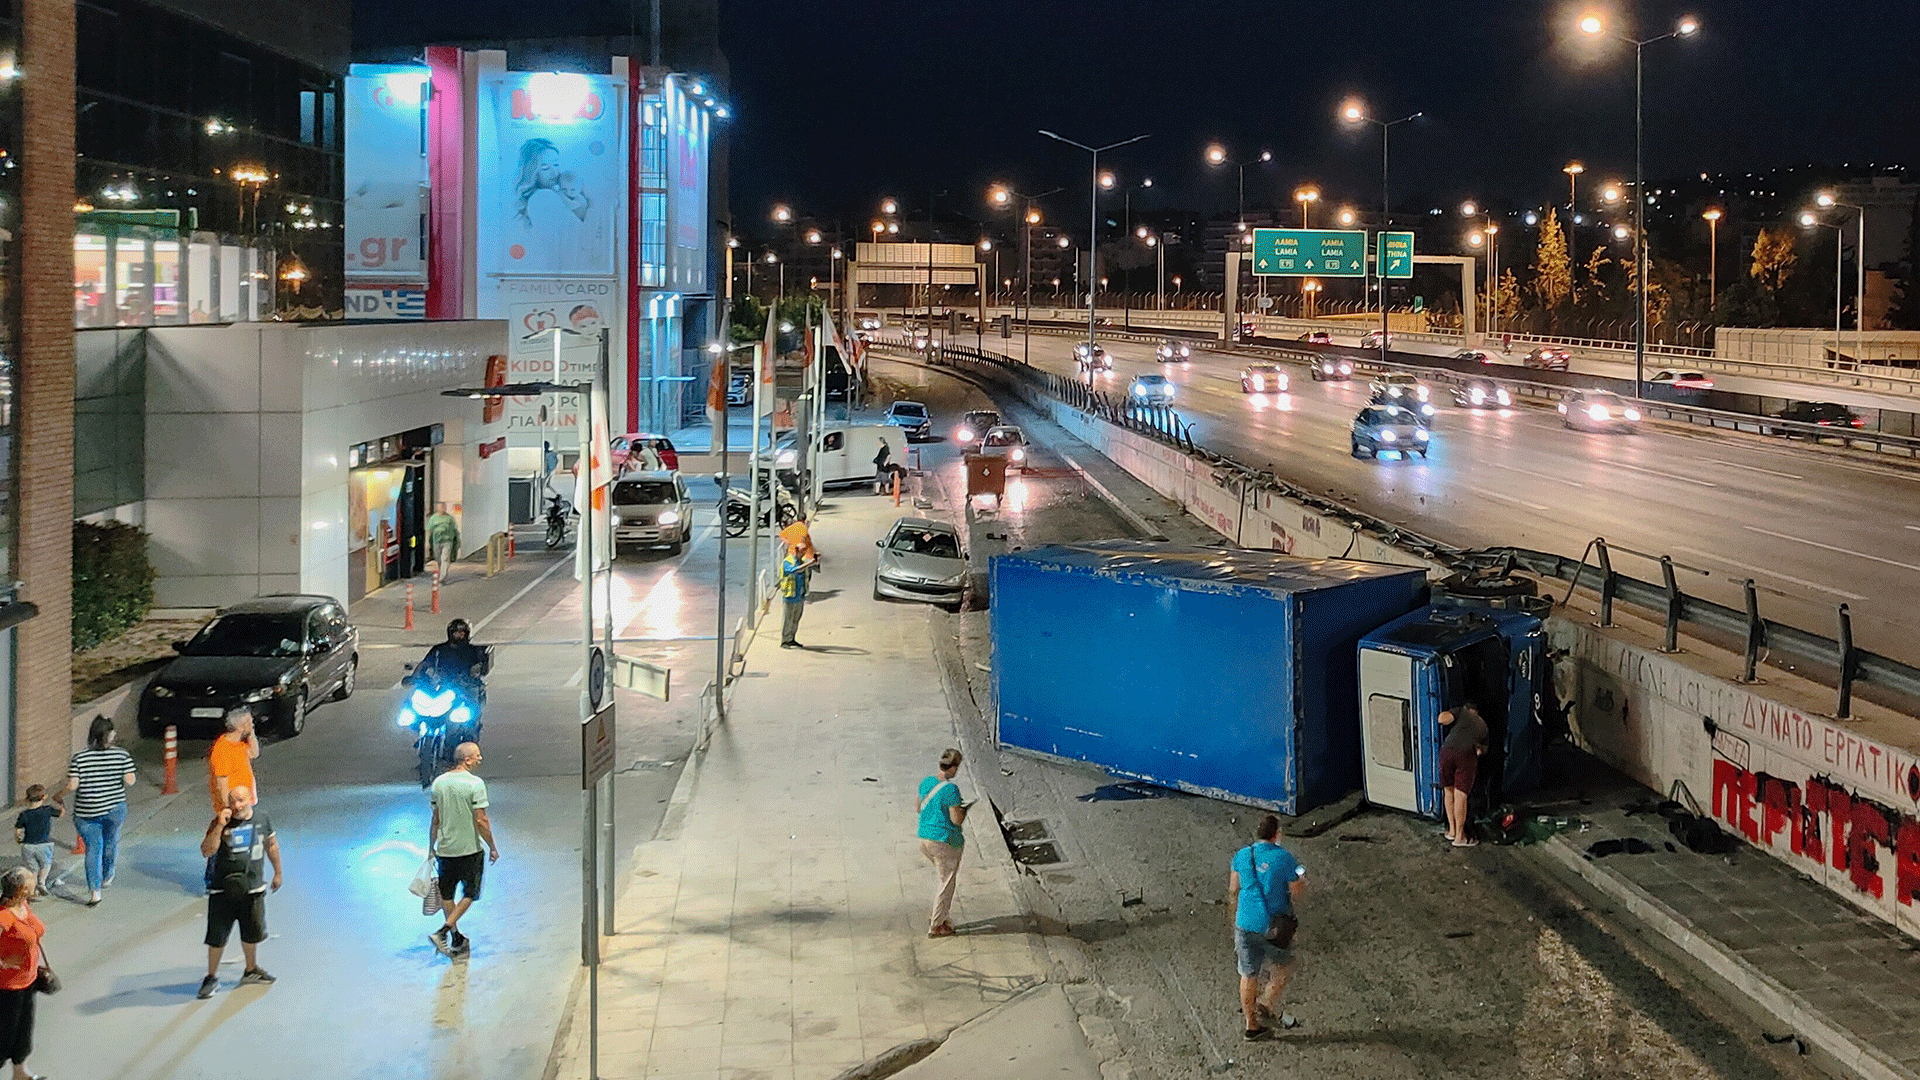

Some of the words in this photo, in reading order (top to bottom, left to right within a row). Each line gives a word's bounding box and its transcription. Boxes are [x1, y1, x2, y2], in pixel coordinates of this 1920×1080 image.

[1275, 248, 1298, 256] LAMIA
[1321, 249, 1344, 257] LAMIA
[1742, 696, 1813, 750] ΔΥΝΑΤΟ
